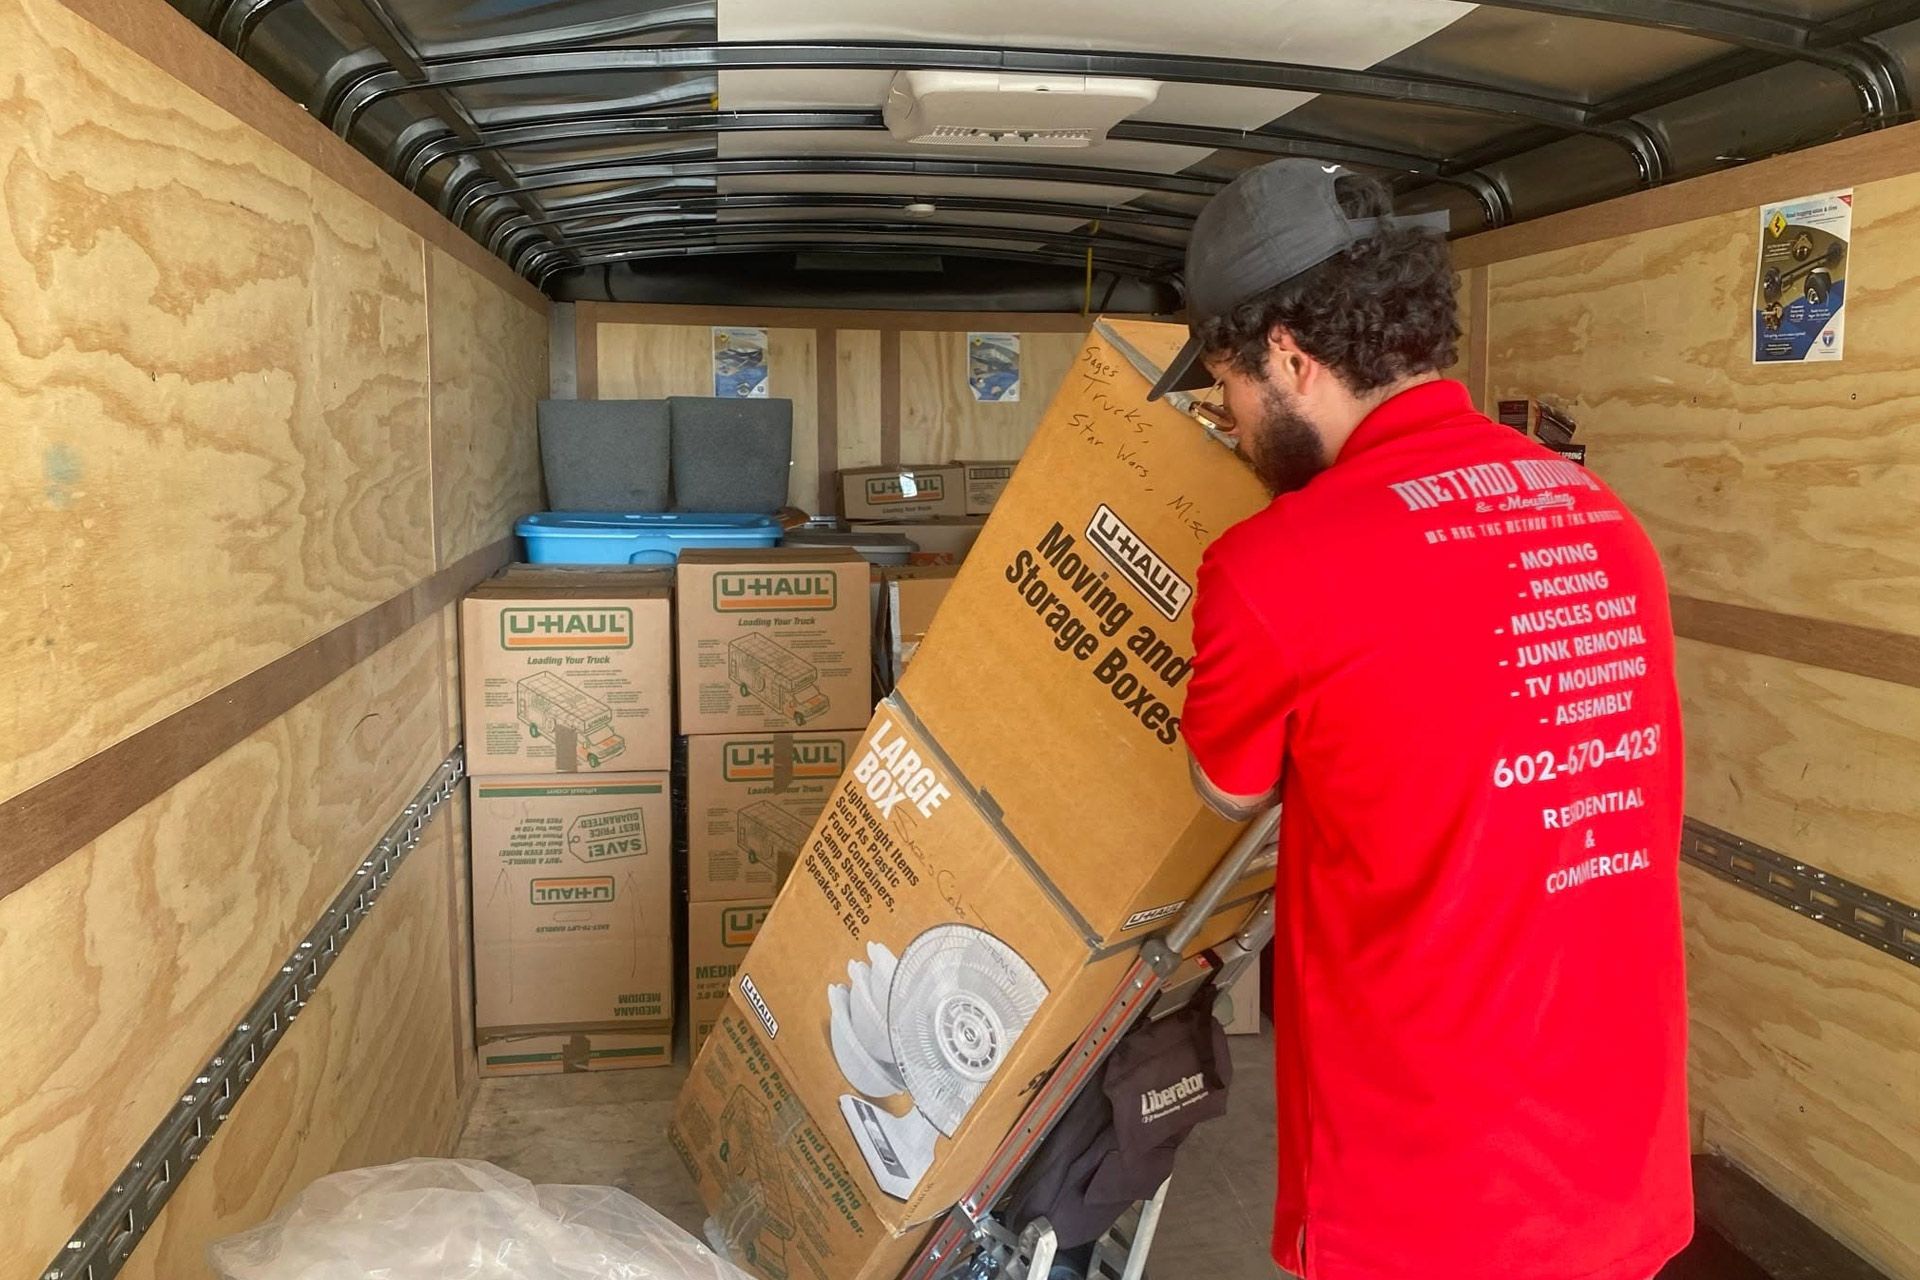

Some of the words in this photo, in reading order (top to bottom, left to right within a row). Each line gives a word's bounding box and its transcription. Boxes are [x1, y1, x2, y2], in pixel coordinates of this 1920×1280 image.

[1068, 413, 1104, 447] Star
[871, 478, 939, 495] U-HUL
[1387, 462, 1518, 512] METHOD
[1475, 501, 1493, 513] &
[1097, 512, 1179, 606] U-HAUL
[1520, 543, 1599, 571] MOVING
[722, 577, 829, 596] U-HAUL
[1036, 521, 1134, 637] Moving
[1127, 626, 1193, 688] and
[1530, 571, 1610, 600] PACKING
[510, 613, 625, 634] U-HAUL
[738, 617, 772, 627] Loading
[774, 617, 792, 626] Your
[794, 617, 816, 625] Truck
[1511, 603, 1593, 636] MUSCLES
[1595, 595, 1638, 620] ONLY
[527, 655, 563, 666] Loading
[565, 656, 588, 665] Your
[587, 655, 611, 664] Truck
[1005, 549, 1099, 661] Storage
[1093, 647, 1182, 745] Boxes
[1516, 639, 1571, 668] JUNK
[1573, 625, 1647, 657] REMOVAL
[1525, 675, 1553, 699] TV
[1558, 656, 1647, 693] MOUNTING
[1555, 690, 1634, 726] ASSEMBLY
[869, 719, 951, 819] LARGE
[1493, 724, 1661, 788] 602-670-423
[853, 751, 907, 820] BOX
[619, 822, 641, 834] BEST
[1543, 786, 1645, 829] REDENTIAL
[588, 838, 641, 857] SAVE!
[589, 825, 615, 838] PRICE
[835, 796, 858, 829] Such
[855, 827, 869, 845] As
[867, 842, 900, 888] Plastic
[843, 780, 894, 852] Lightweight
[890, 847, 920, 887] Items
[1585, 829, 1596, 849] &
[812, 840, 841, 888] Games,
[840, 882, 870, 926] Stereo
[820, 825, 842, 861] Lamp
[841, 855, 873, 909] Shades,
[828, 811, 851, 843] Food
[850, 841, 895, 913] Containers,
[535, 886, 609, 900] U-HAUL
[805, 855, 842, 916] Speakers,
[843, 911, 860, 941] Etc.
[614, 1005, 661, 1017] MEDIANA
[618, 992, 661, 1004] MEDIUM
[744, 978, 777, 1033] U-HAUL
[737, 1019, 748, 1034] to
[747, 1034, 771, 1073] Make
[803, 1126, 824, 1153] and
[822, 1154, 862, 1210] Loading
[1141, 1072, 1205, 1116] Liberator
[745, 1055, 760, 1076] for
[758, 1077, 775, 1101] the
[831, 1191, 866, 1239] Mover.
